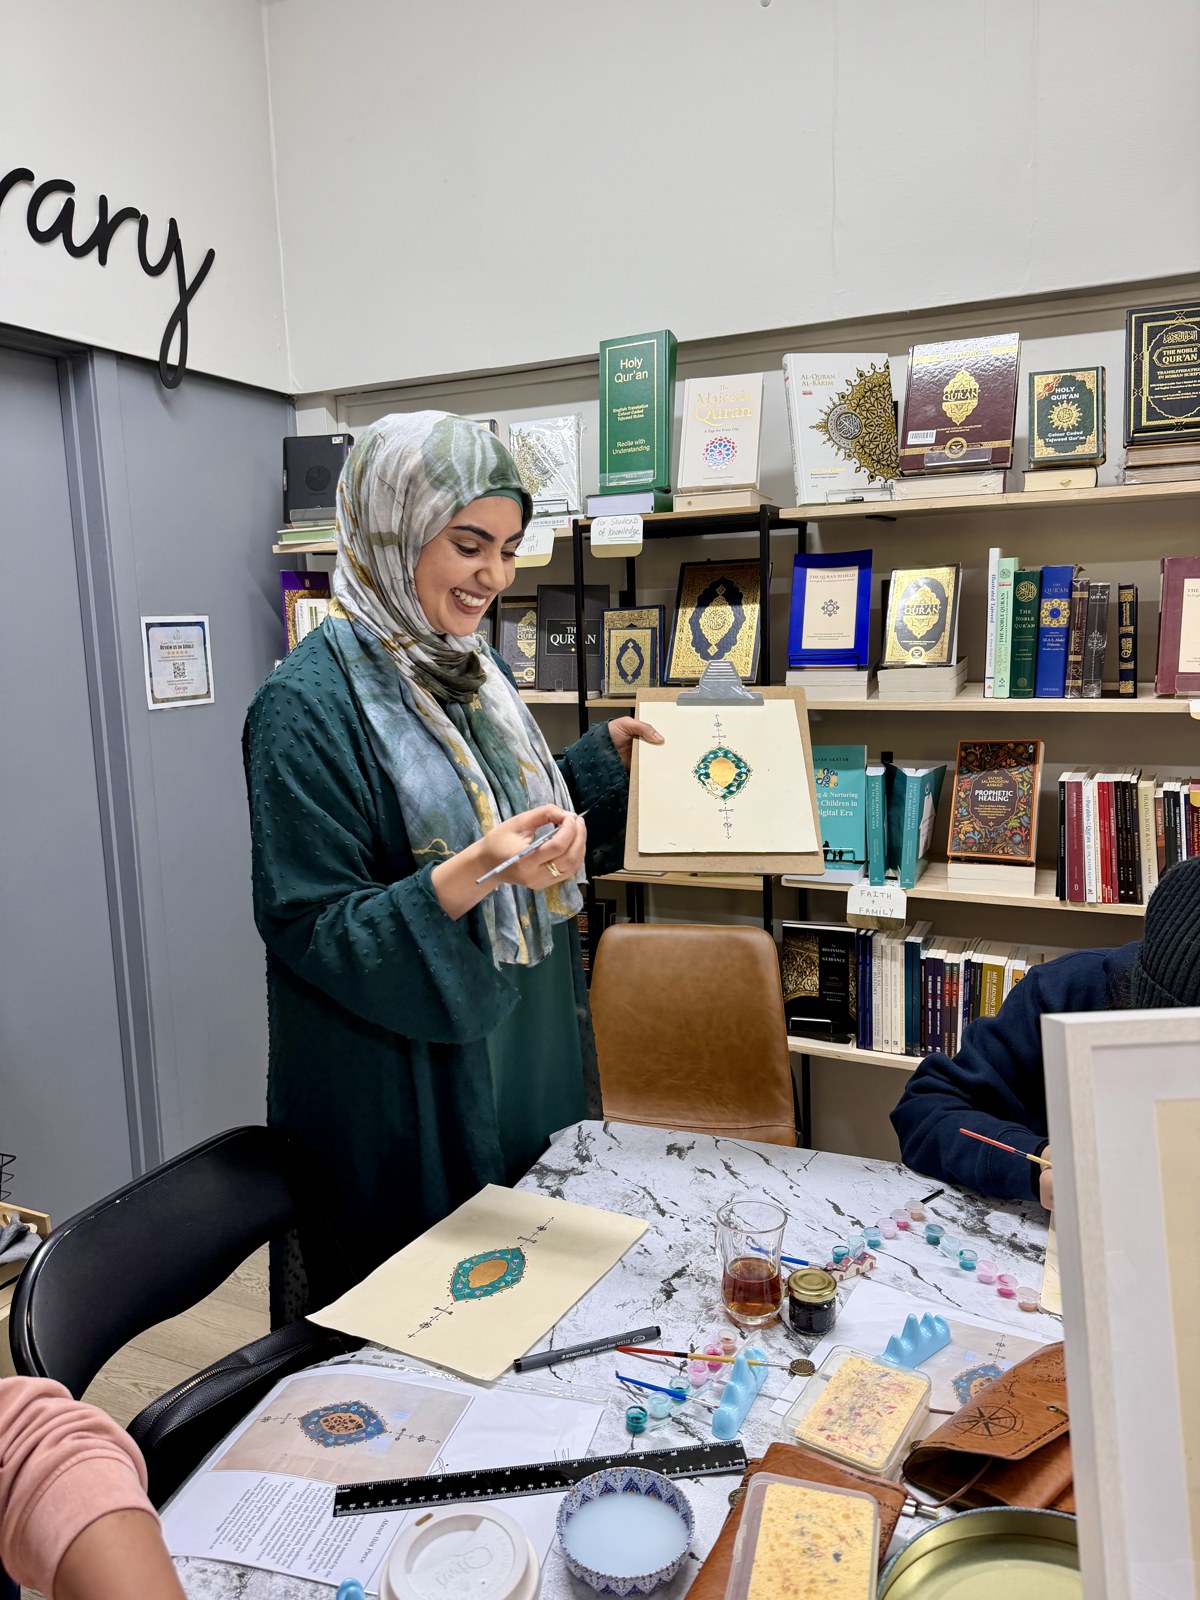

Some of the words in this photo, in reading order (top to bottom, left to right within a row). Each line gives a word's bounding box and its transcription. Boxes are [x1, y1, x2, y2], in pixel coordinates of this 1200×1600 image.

[620, 356, 643, 370] Holy
[614, 370, 649, 383] Qur'an
[1055, 386, 1075, 394] HOLY
[942, 389, 979, 402] QURAN
[1050, 393, 1080, 401] QUR'AN
[694, 405, 752, 427] Quran
[612, 445, 651, 455] Understanding
[610, 516, 640, 526] Students
[903, 606, 940, 616] QURAN
[566, 626, 577, 634] TH
[550, 634, 597, 646] QURN
[830, 791, 859, 799] Nurturing
[974, 789, 1014, 797] PROPHETIC
[820, 799, 850, 807] Children
[860, 890, 892, 900] FAITH
[858, 906, 895, 916] FAMILY
[566, 1348, 591, 1359] STAEDTLER
[592, 1344, 608, 1353] pigment
[374, 1518, 390, 1535] About
[367, 1535, 380, 1547] this
[358, 1547, 373, 1563] Piece
